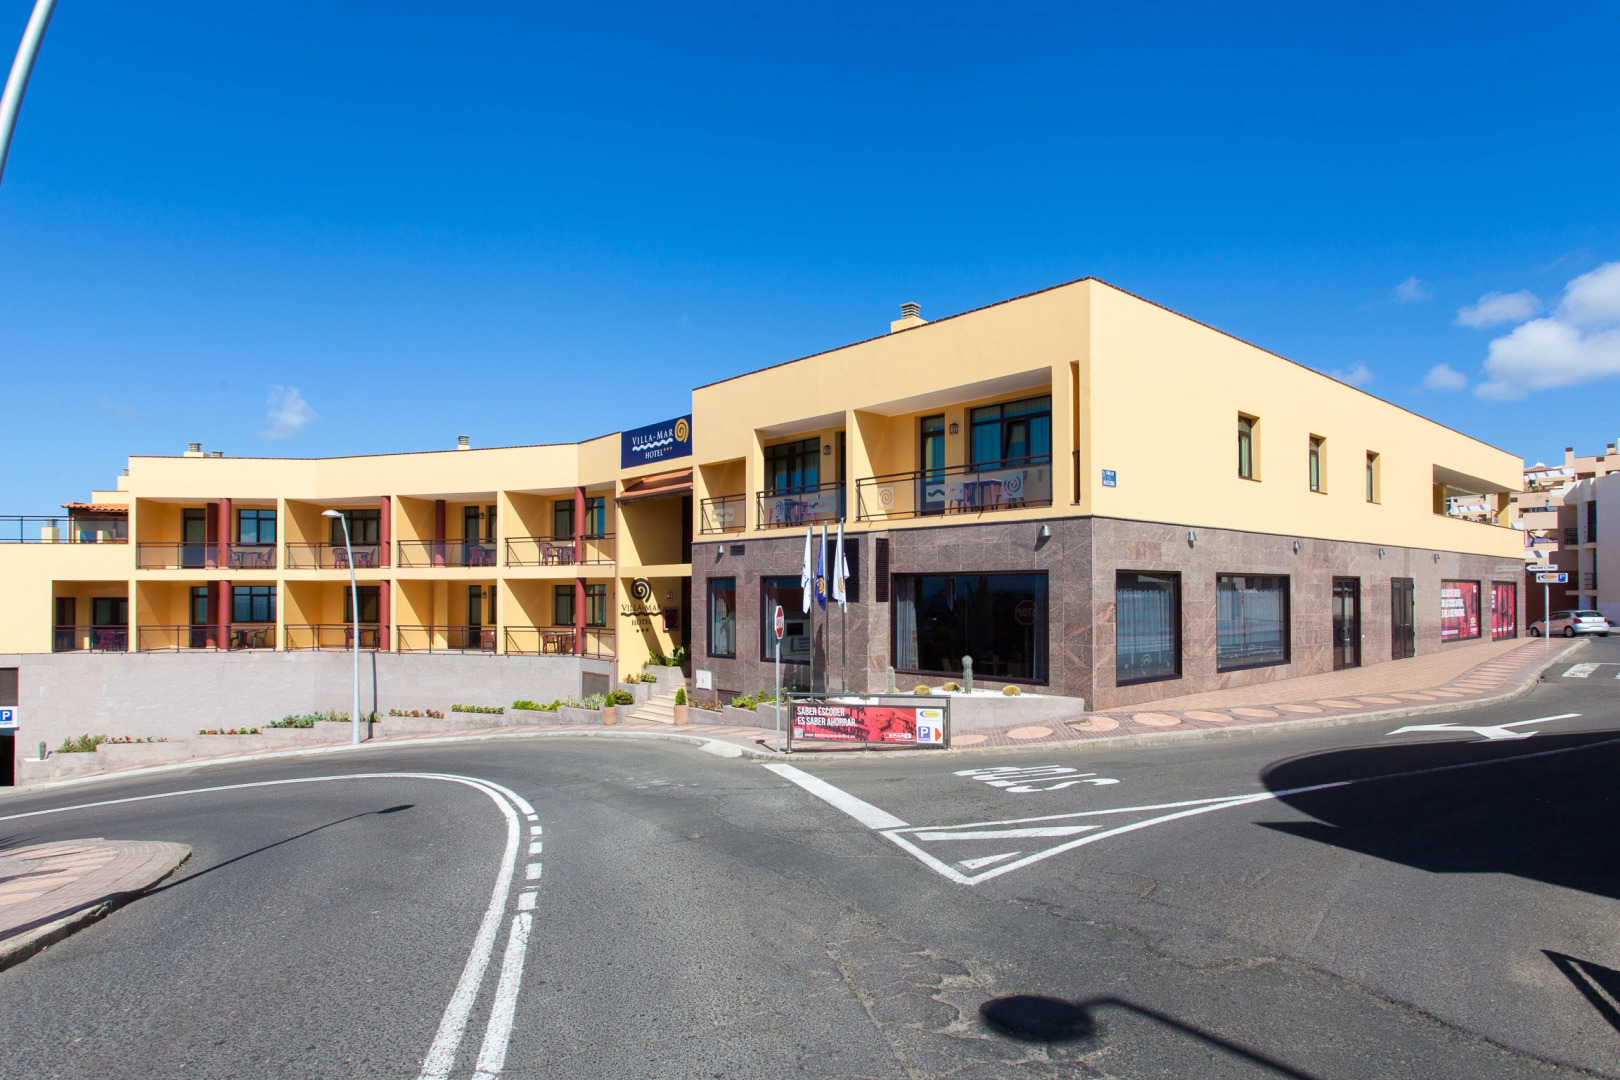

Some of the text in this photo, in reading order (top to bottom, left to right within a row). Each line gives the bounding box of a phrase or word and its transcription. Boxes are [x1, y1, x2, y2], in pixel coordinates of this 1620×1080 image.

[632, 428, 673, 445] VILLA-MAR
[645, 449, 663, 459] HOTEL
[2, 711, 11, 721] P
[797, 706, 845, 717] SABER ESCOGER
[797, 716, 806, 725] ES
[806, 717, 826, 726] SABER
[920, 727, 929, 738] P
